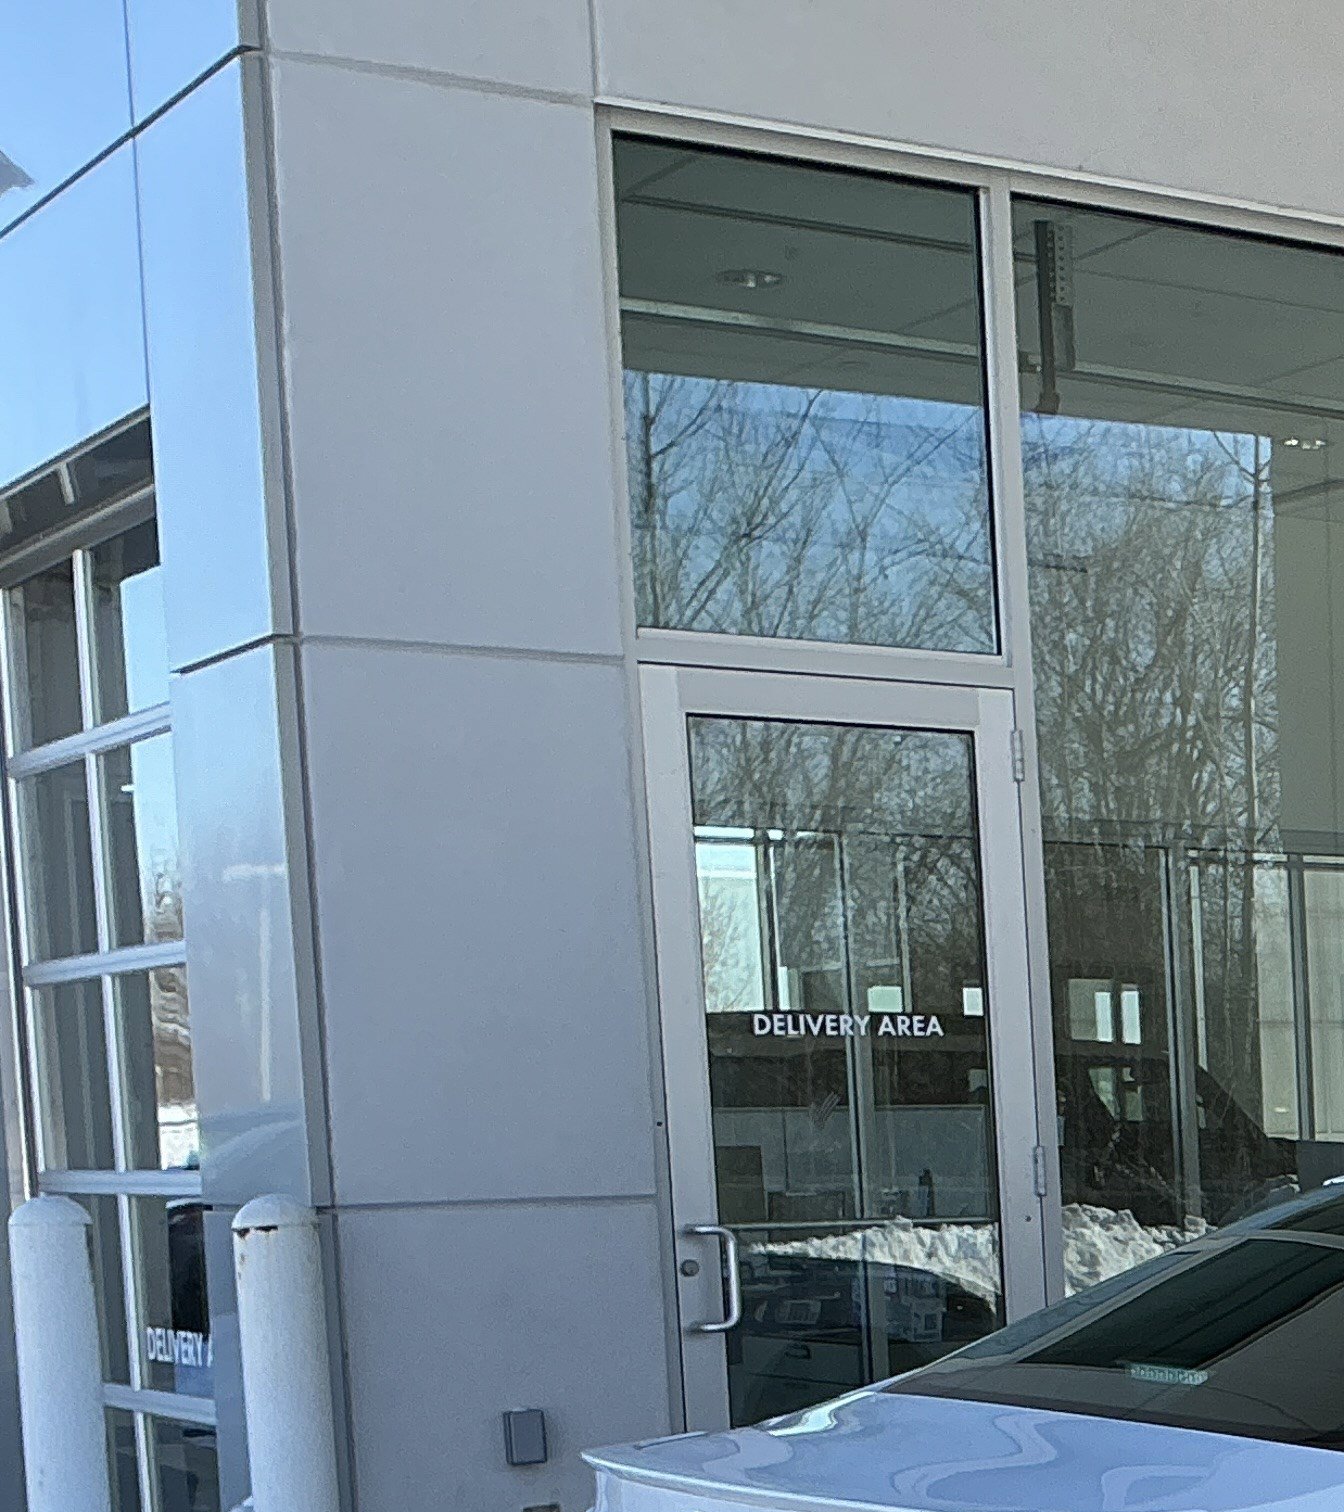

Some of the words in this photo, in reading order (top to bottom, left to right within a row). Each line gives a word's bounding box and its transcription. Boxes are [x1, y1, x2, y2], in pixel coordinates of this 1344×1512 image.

[753, 1013, 871, 1036] DELIVERY
[877, 1015, 945, 1037] AREA
[147, 1327, 203, 1367] DELIVERY
